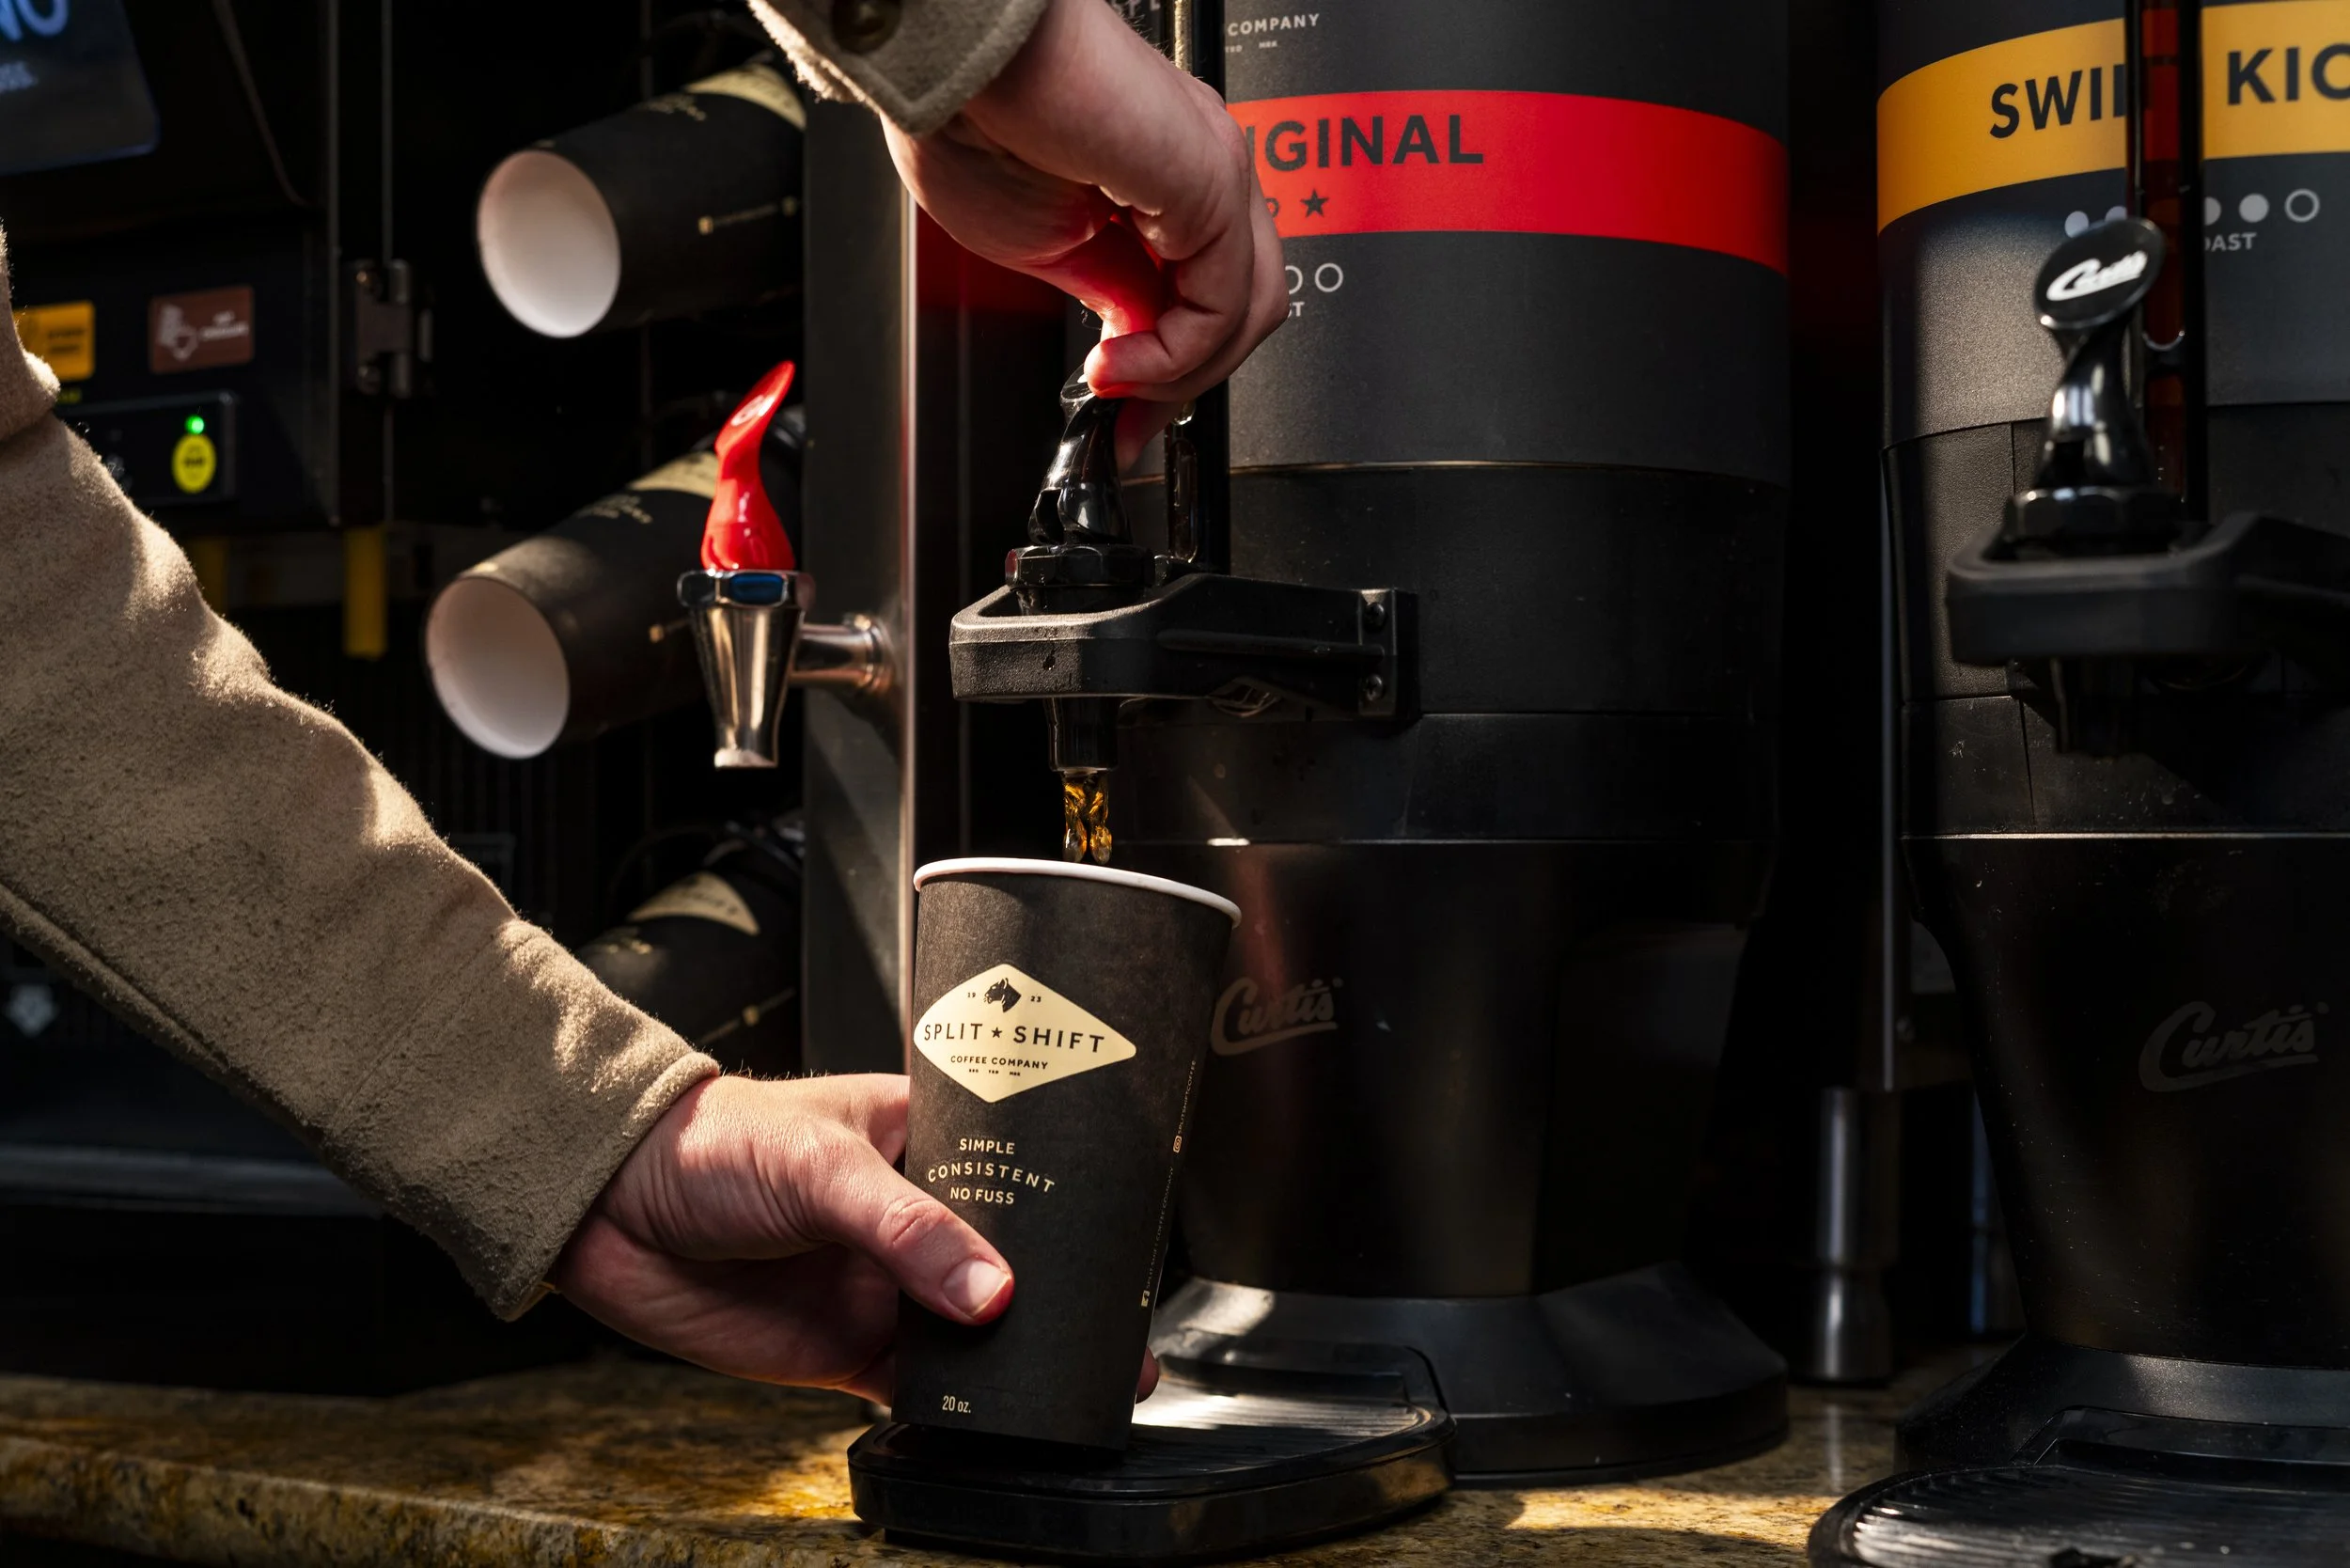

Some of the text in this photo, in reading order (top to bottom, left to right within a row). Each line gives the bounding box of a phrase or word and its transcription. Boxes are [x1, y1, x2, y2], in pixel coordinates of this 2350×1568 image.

[1227, 13, 1320, 37] COMPANY
[1210, 976, 1340, 1057] Curtis
[924, 1023, 1104, 1054] SPLIT SHIFT
[2138, 1000, 2320, 1093] Curtis
[950, 1055, 1049, 1071] COFFEE COMPANY
[959, 1137, 1015, 1155] SIMPLE
[928, 1161, 1056, 1193] CONSISTENT
[949, 1186, 1015, 1205] NO FUSS
[942, 1395, 972, 1414] 20 oz.
